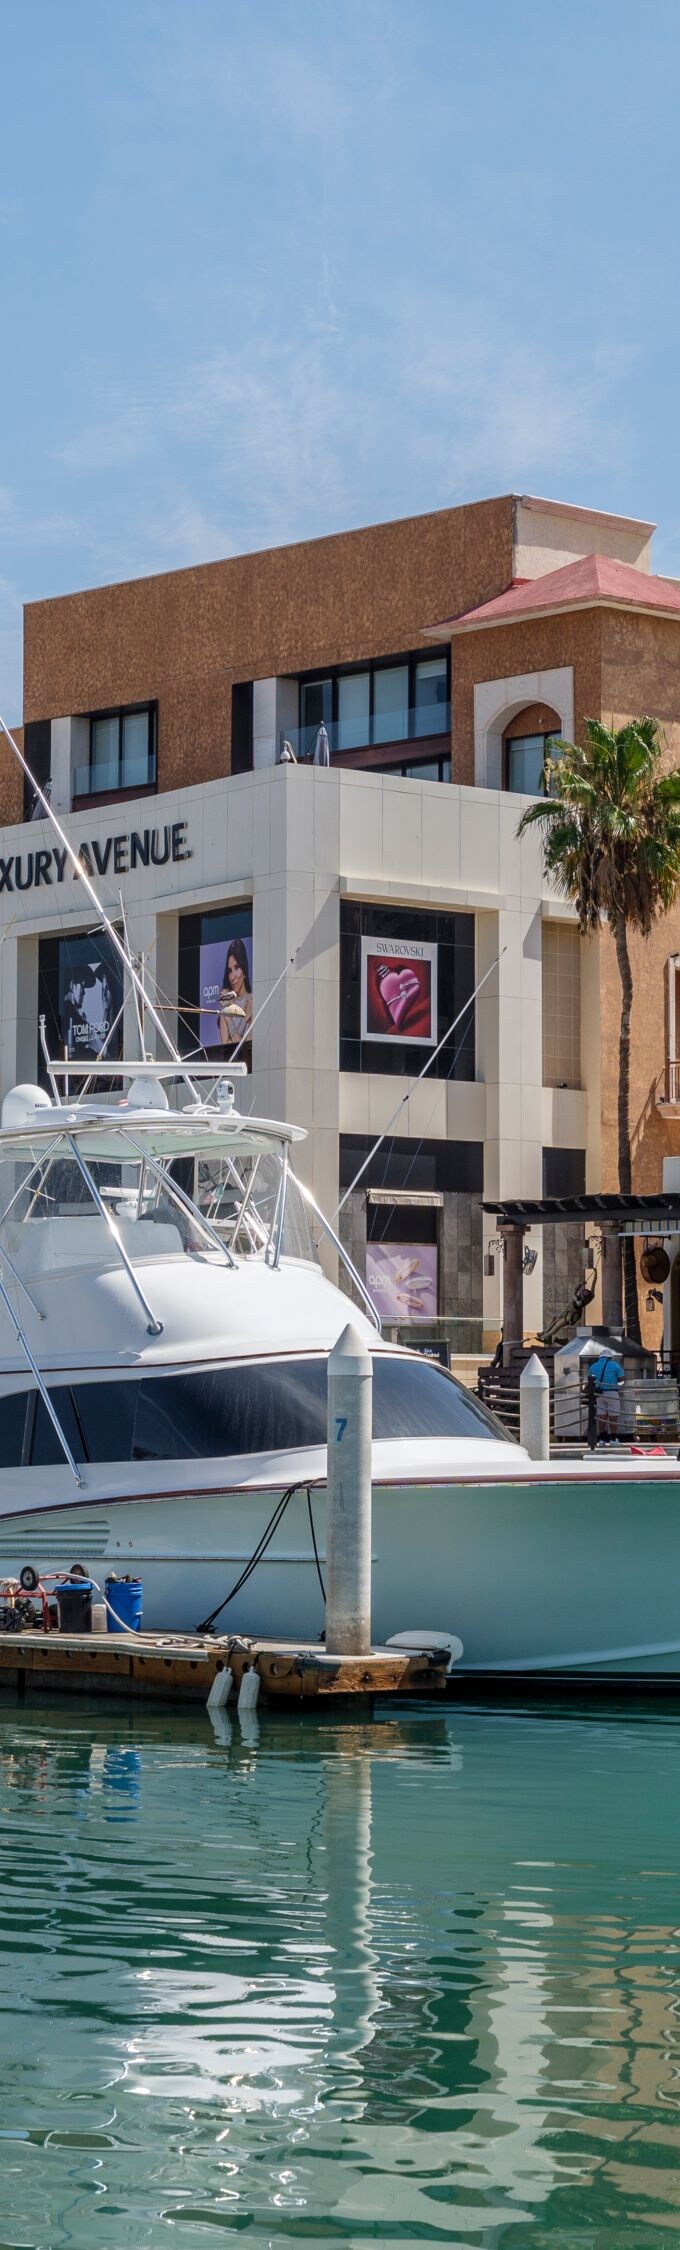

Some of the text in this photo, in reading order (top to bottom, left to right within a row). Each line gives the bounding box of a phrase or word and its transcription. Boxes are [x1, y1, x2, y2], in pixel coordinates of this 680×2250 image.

[376, 943, 424, 957] SWAROVSKI
[73, 1024, 89, 1036] TOM
[335, 1418, 348, 1442] 7
